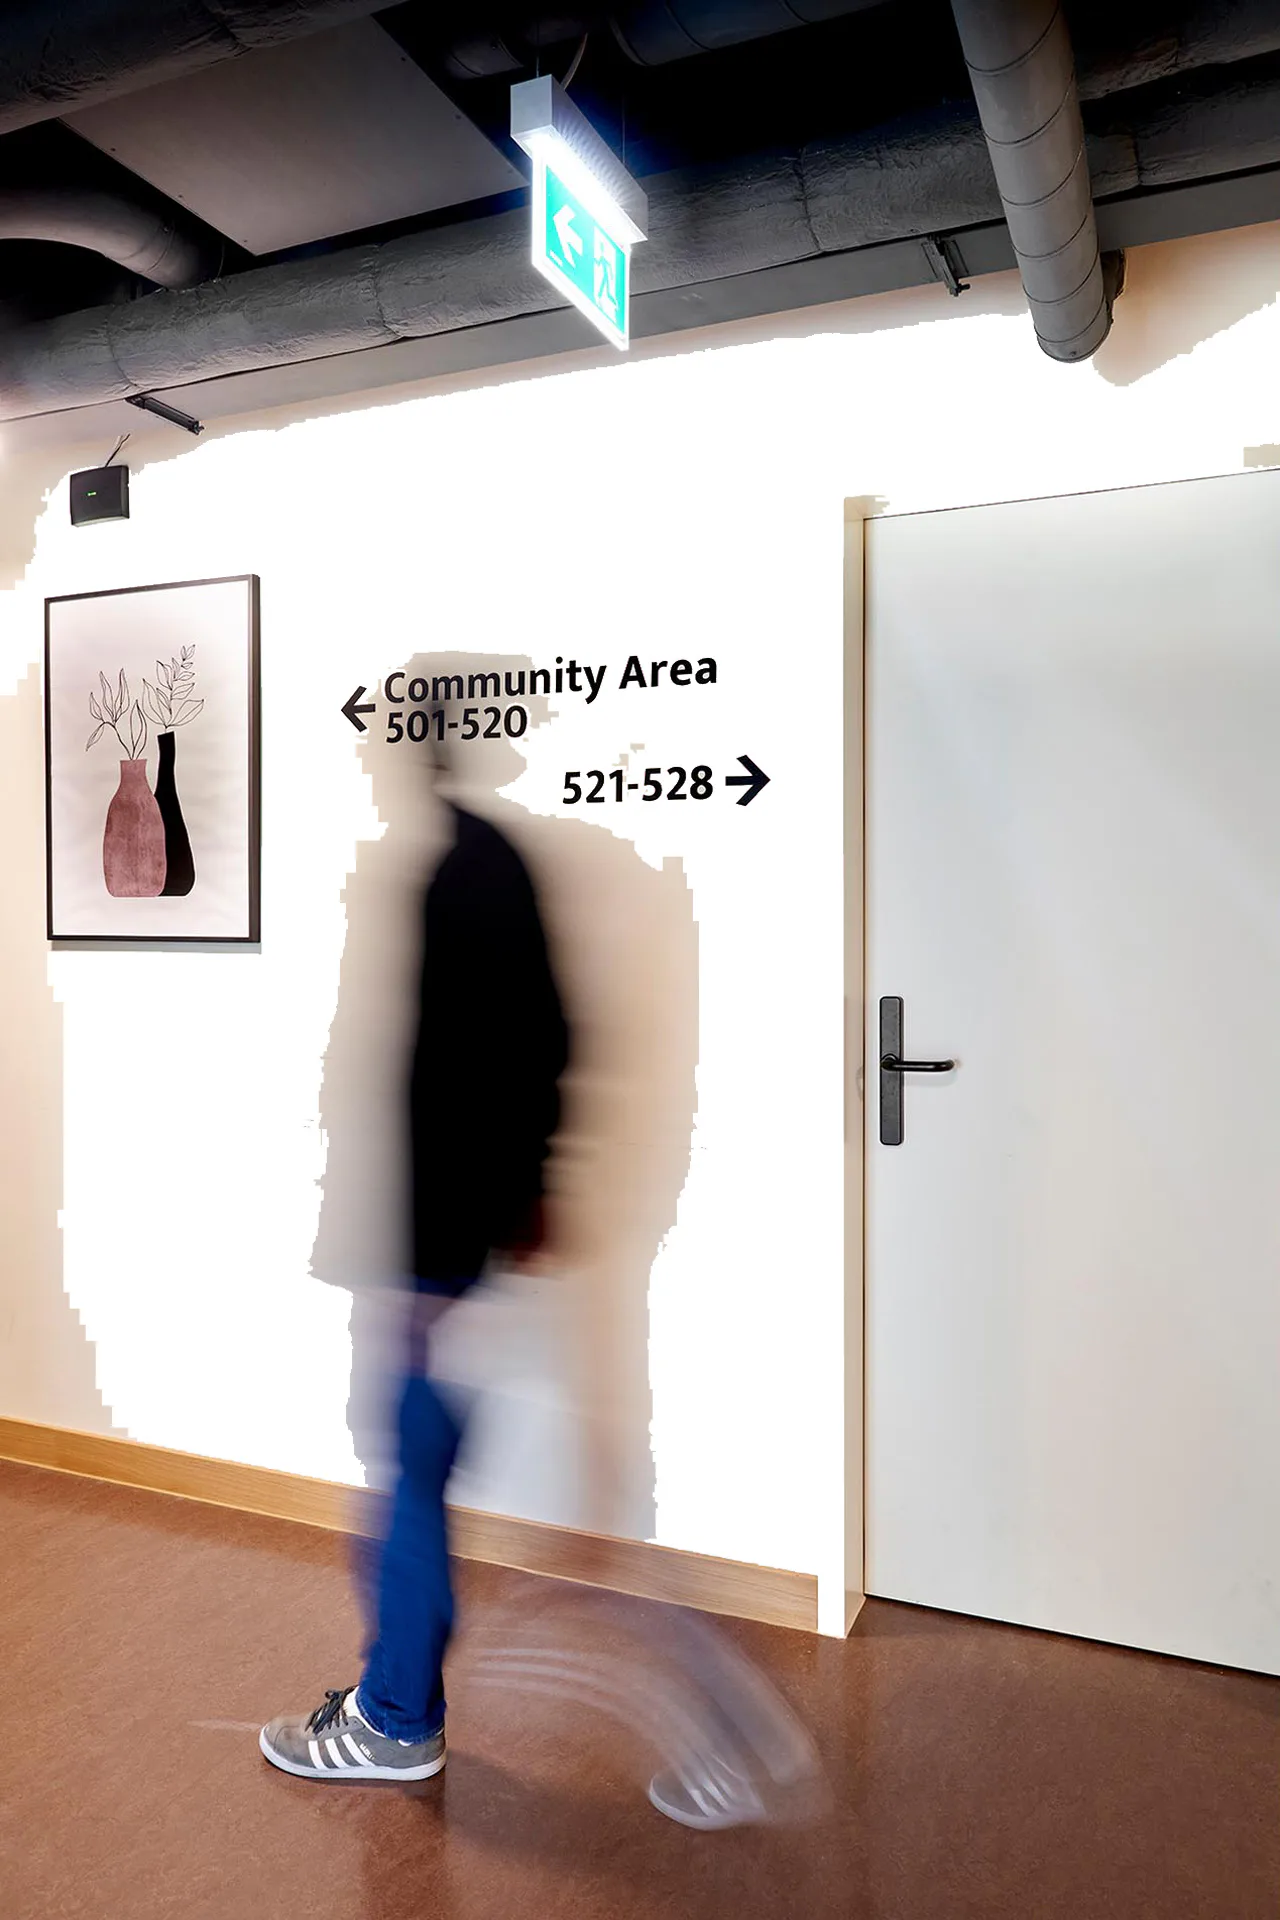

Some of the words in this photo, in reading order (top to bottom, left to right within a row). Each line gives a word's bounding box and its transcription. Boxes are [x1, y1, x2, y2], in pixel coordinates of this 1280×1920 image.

[386, 656, 607, 704] Community
[619, 655, 717, 689] Area
[386, 705, 527, 743] 501-520
[562, 765, 713, 804] 521-528
